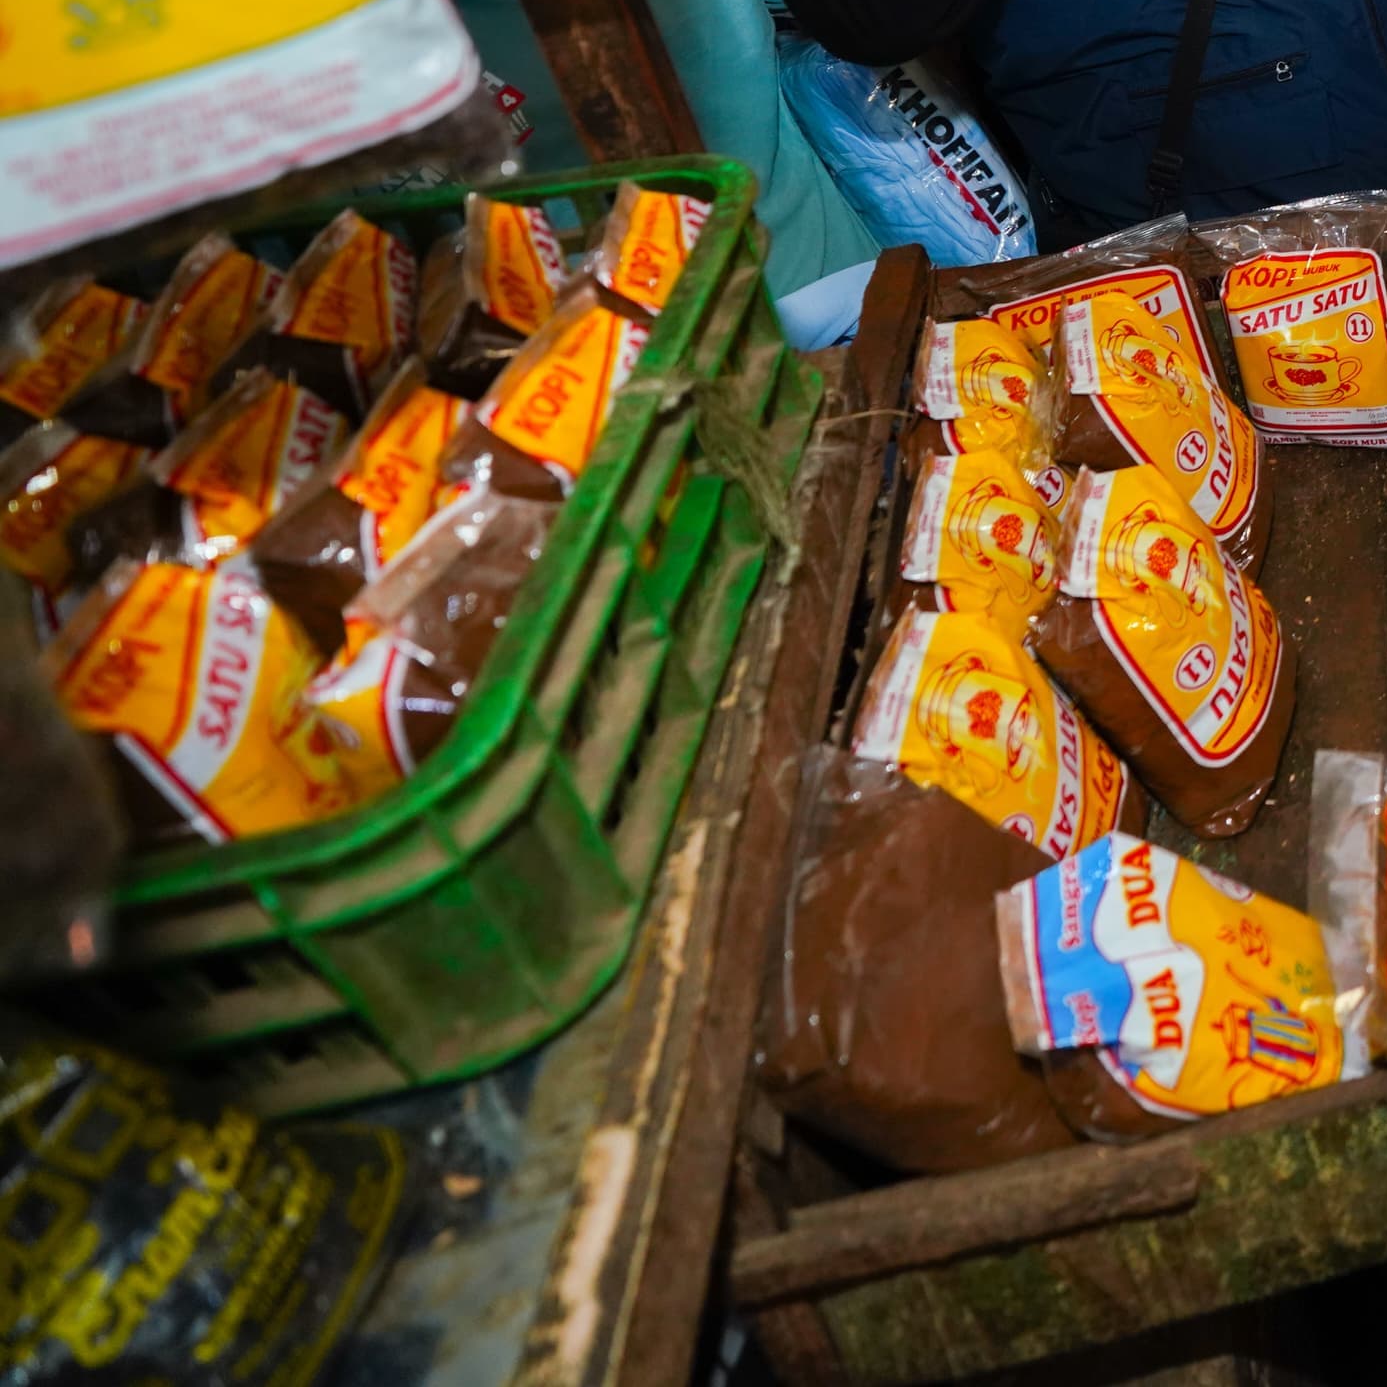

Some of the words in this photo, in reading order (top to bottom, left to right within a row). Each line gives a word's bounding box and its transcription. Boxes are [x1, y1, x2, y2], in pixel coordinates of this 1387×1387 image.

[1238, 266, 1298, 289] KOPI
[1239, 302, 1304, 334] SATU
[1313, 280, 1368, 314] SATU
[1351, 319, 1369, 336] 11
[510, 362, 585, 440] KOPI
[1181, 435, 1205, 467] 11
[199, 640, 249, 751] SATU
[1183, 649, 1212, 684] 11
[1210, 622, 1249, 720] SATU
[1048, 783, 1077, 862] SAT
[1120, 842, 1161, 930] DUA
[1144, 967, 1184, 1049] DUA
